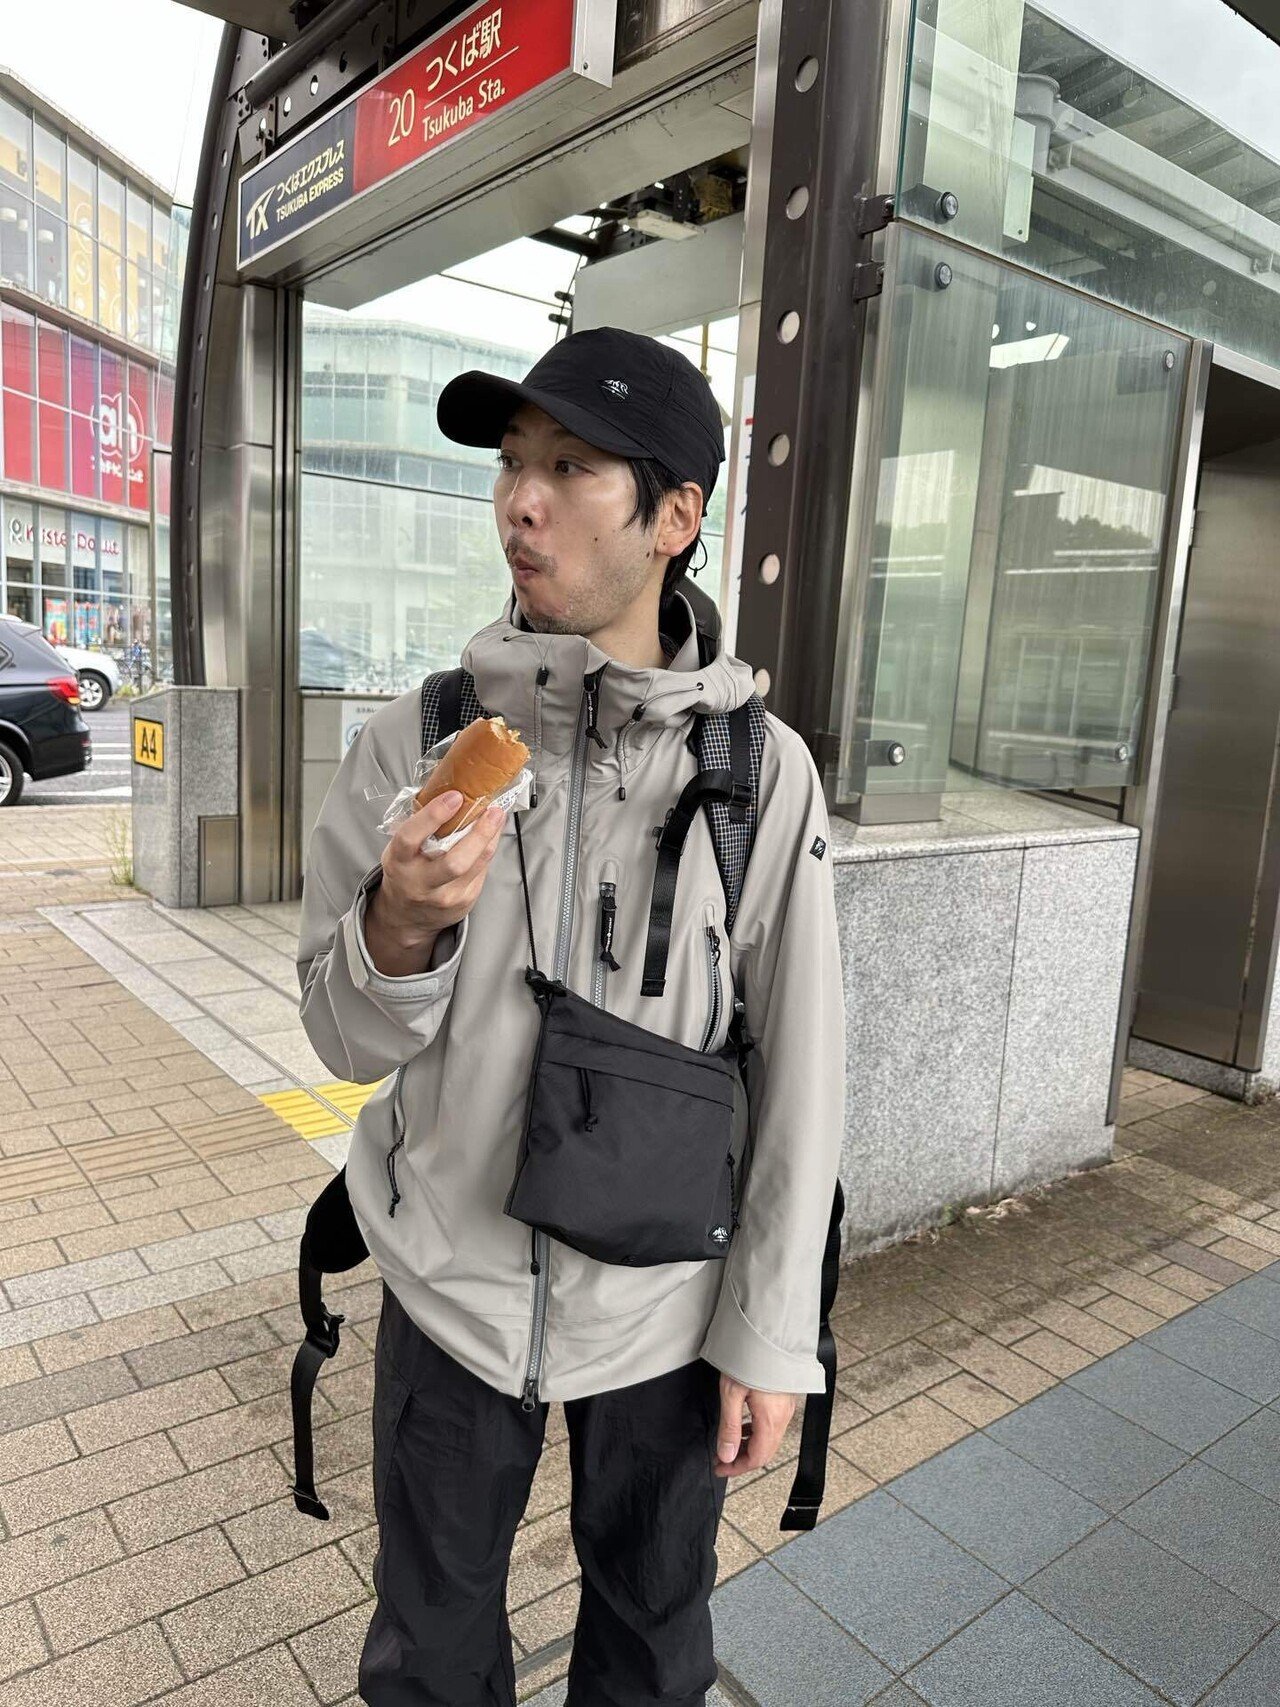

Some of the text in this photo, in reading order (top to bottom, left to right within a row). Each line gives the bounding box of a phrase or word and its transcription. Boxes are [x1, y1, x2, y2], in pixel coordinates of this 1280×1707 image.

[425, 8, 502, 92] つくば駅
[388, 89, 415, 147] 20
[422, 79, 506, 142] Tsukuba Sta.
[276, 166, 344, 222] TSUKUBA EXPRESS
[140, 726, 157, 761] A4
